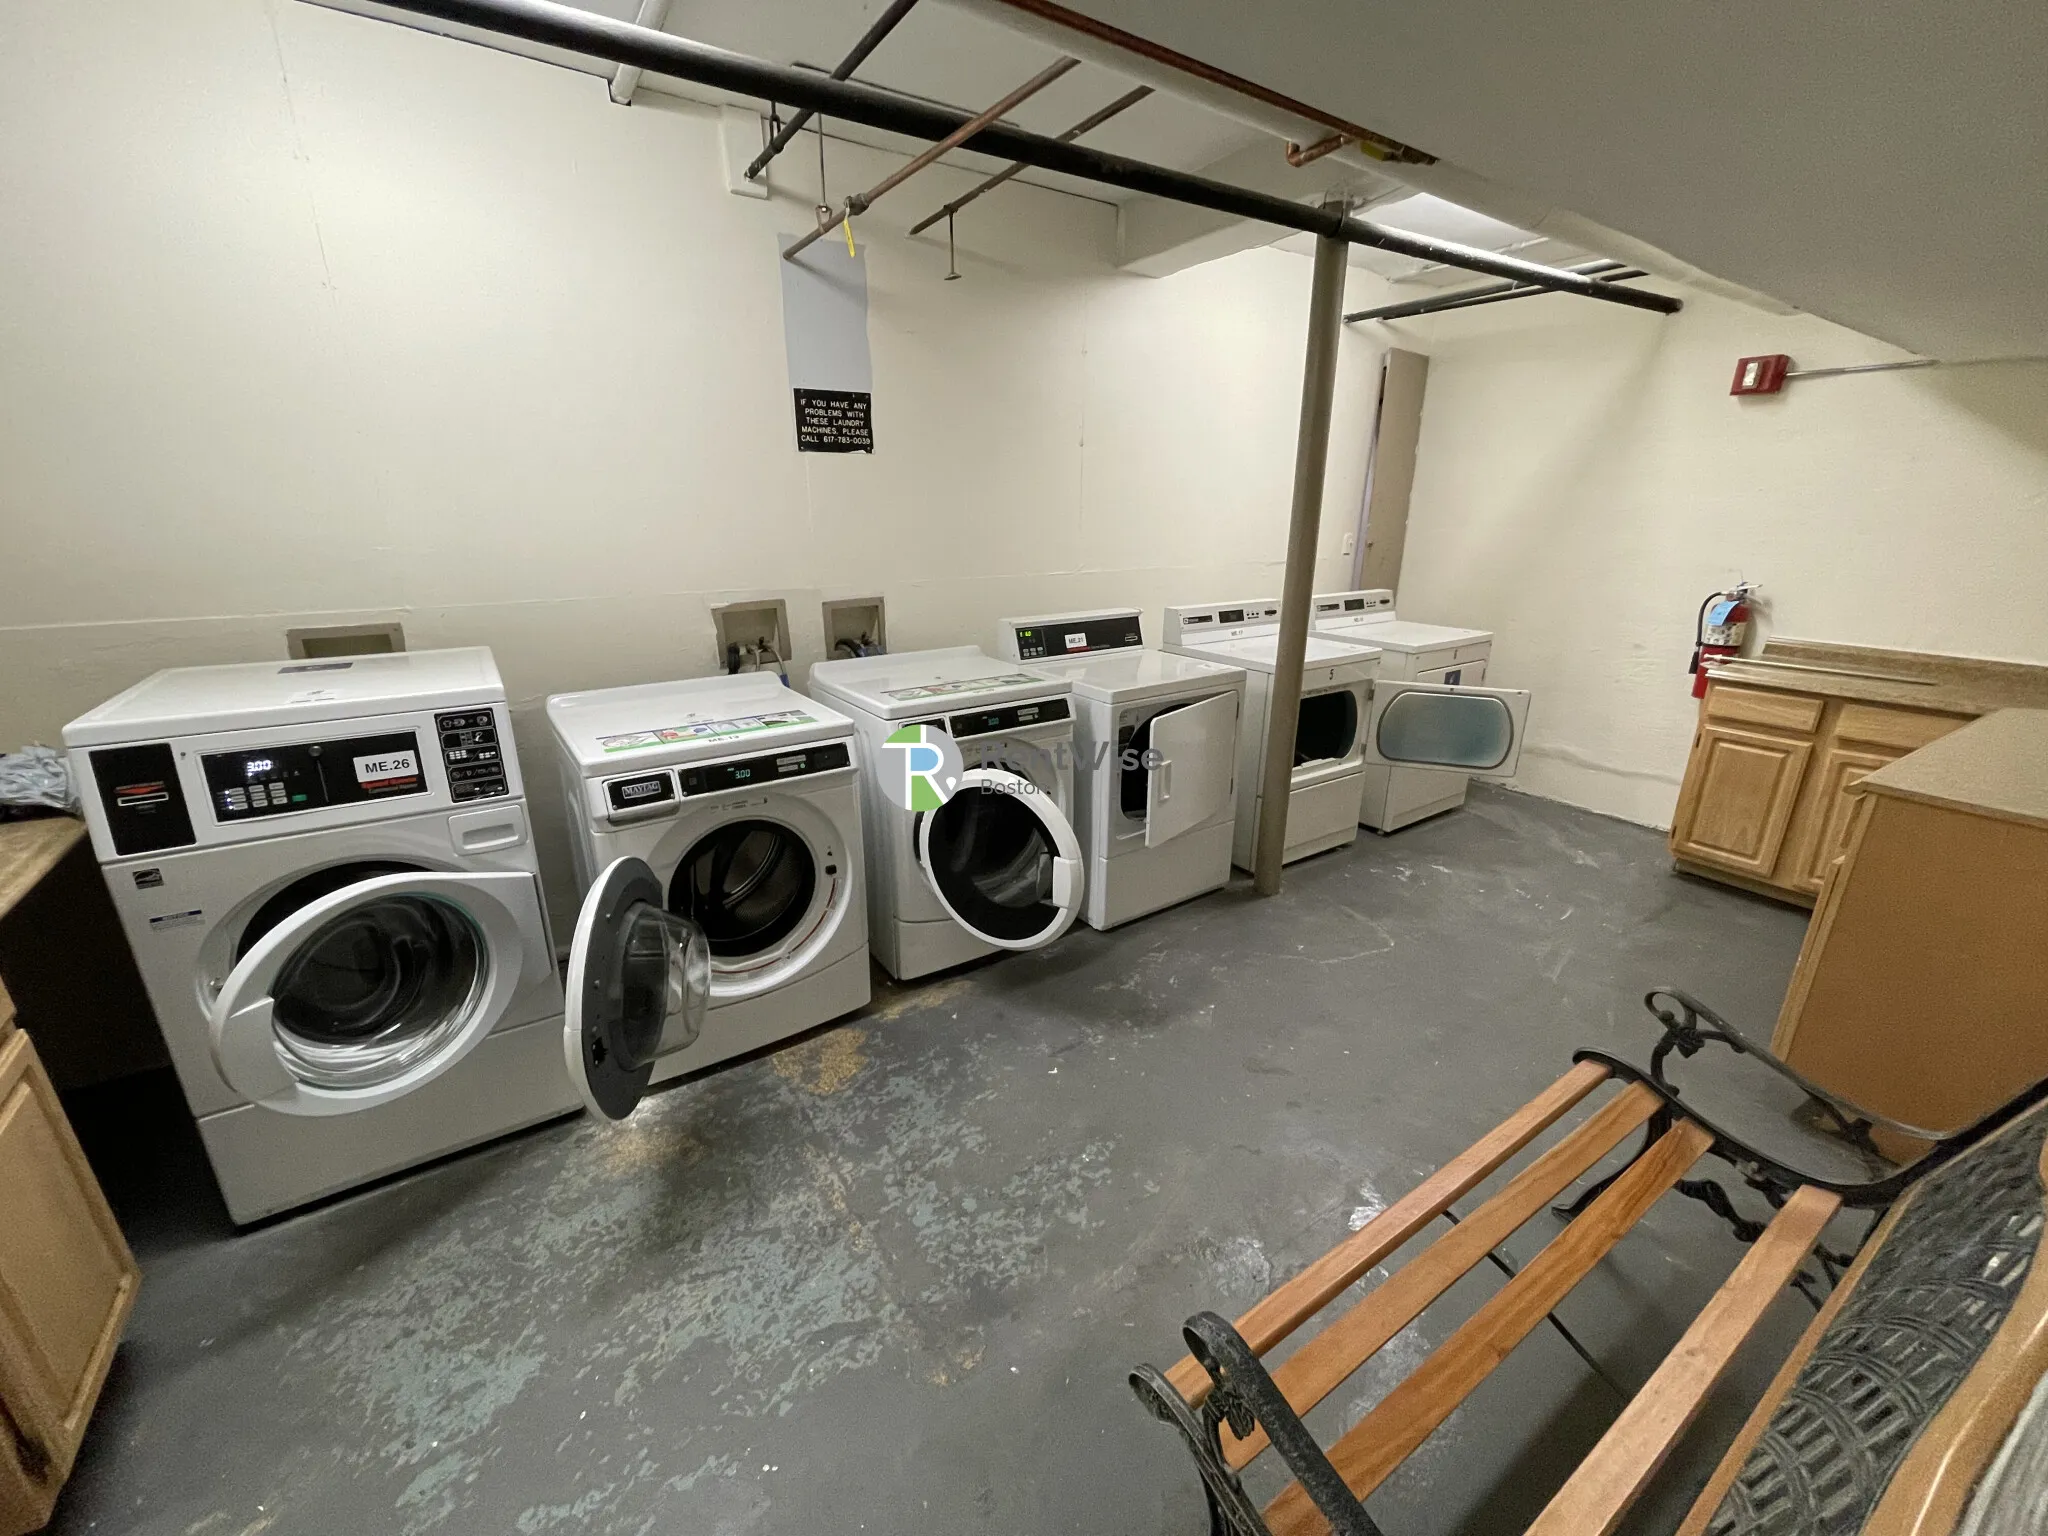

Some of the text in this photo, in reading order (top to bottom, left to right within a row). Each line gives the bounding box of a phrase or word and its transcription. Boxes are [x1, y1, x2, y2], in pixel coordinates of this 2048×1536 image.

[805, 408, 864, 418] PROBLEMS WITH
[806, 417, 864, 427] THESE LAUNDRY
[842, 428, 869, 436] PLEASE
[365, 758, 410, 774] ME.26
